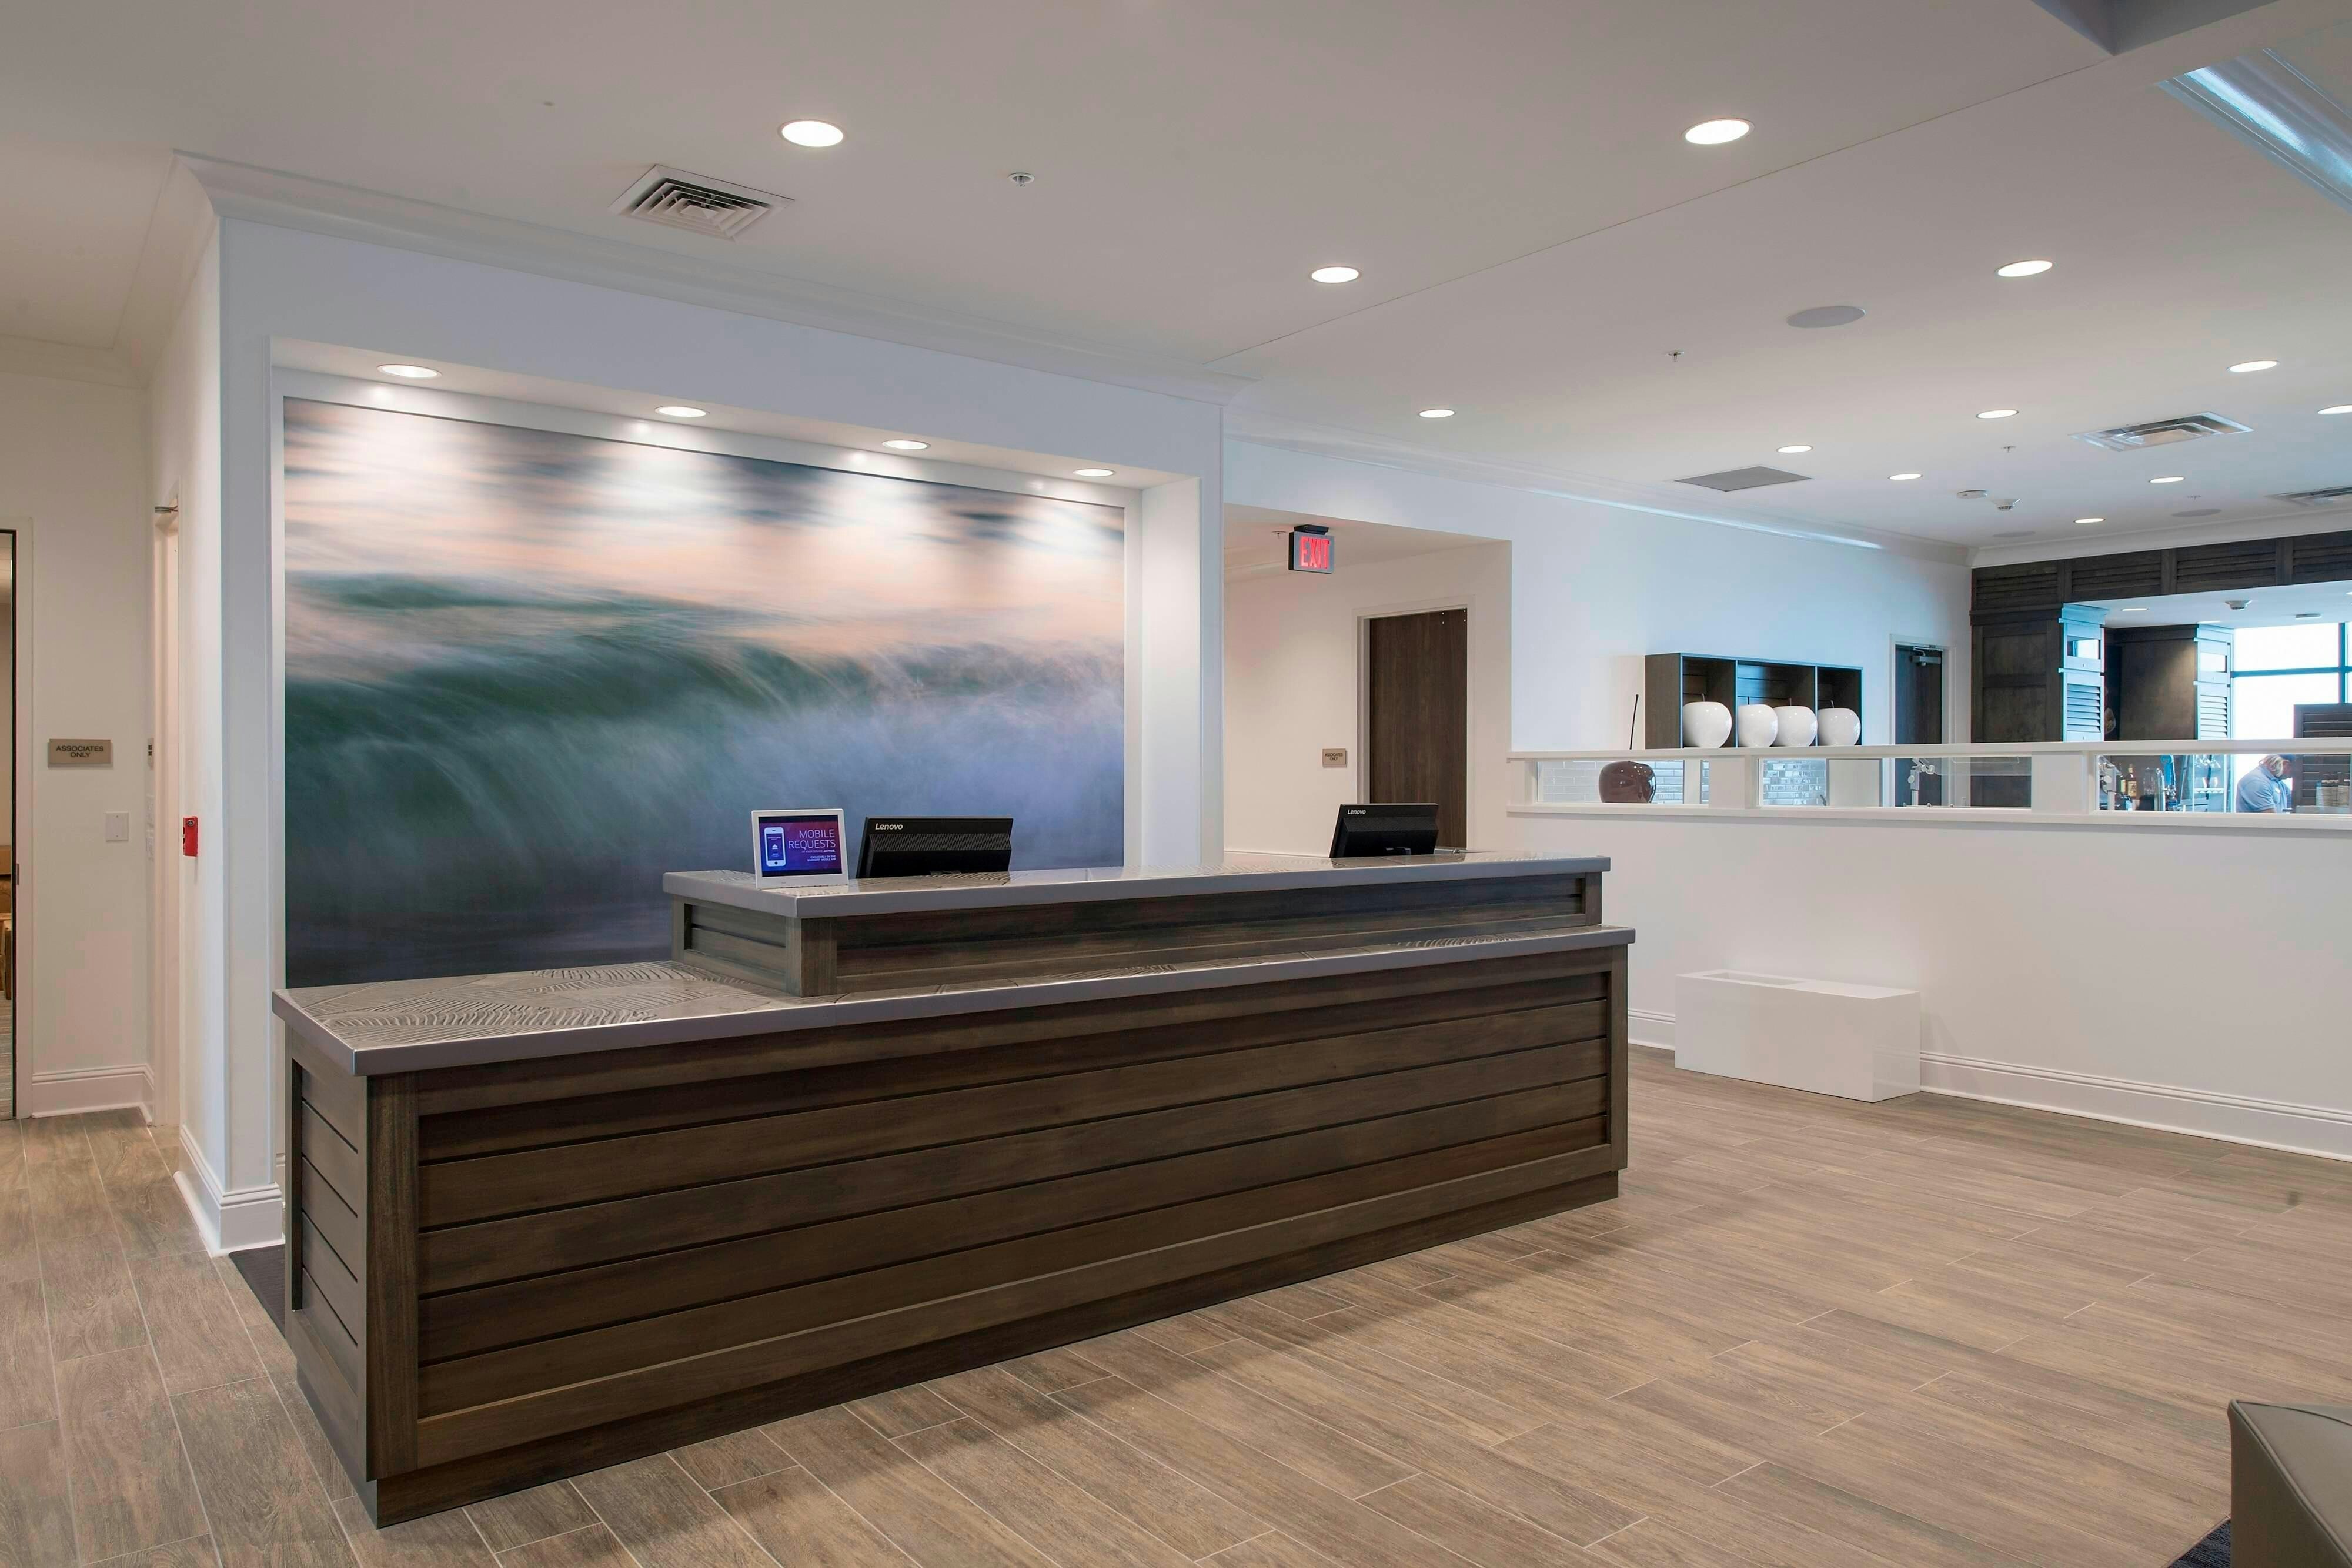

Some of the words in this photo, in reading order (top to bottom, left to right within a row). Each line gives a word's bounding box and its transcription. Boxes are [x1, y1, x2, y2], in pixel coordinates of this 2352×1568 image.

[1300, 536, 1330, 569] EXIT
[799, 829, 835, 838] MOBILE
[788, 839, 836, 850] REQUESTS
